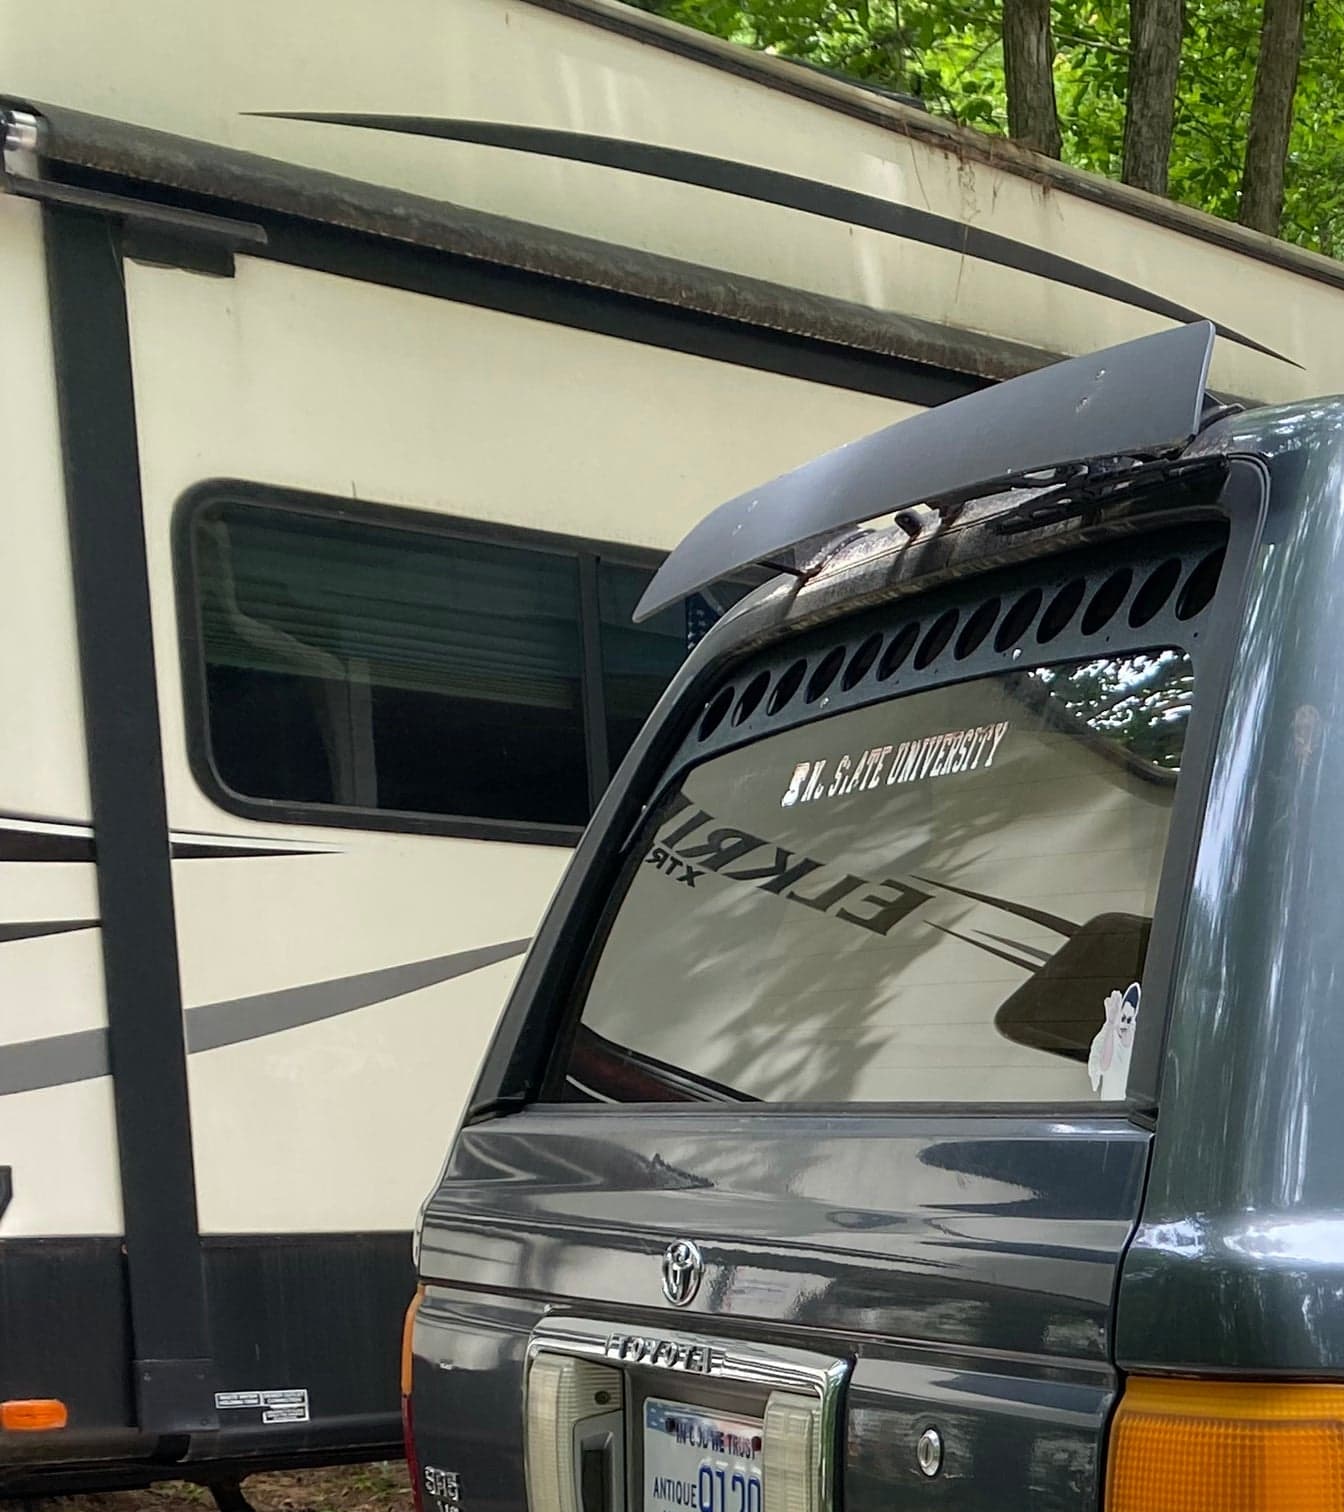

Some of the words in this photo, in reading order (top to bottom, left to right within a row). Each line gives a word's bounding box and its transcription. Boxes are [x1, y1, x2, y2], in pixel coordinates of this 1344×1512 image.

[886, 721, 1009, 785] UNIVERSITY
[604, 1333, 713, 1374] TOYOTA
[653, 1476, 697, 1509] ANTIQUE
